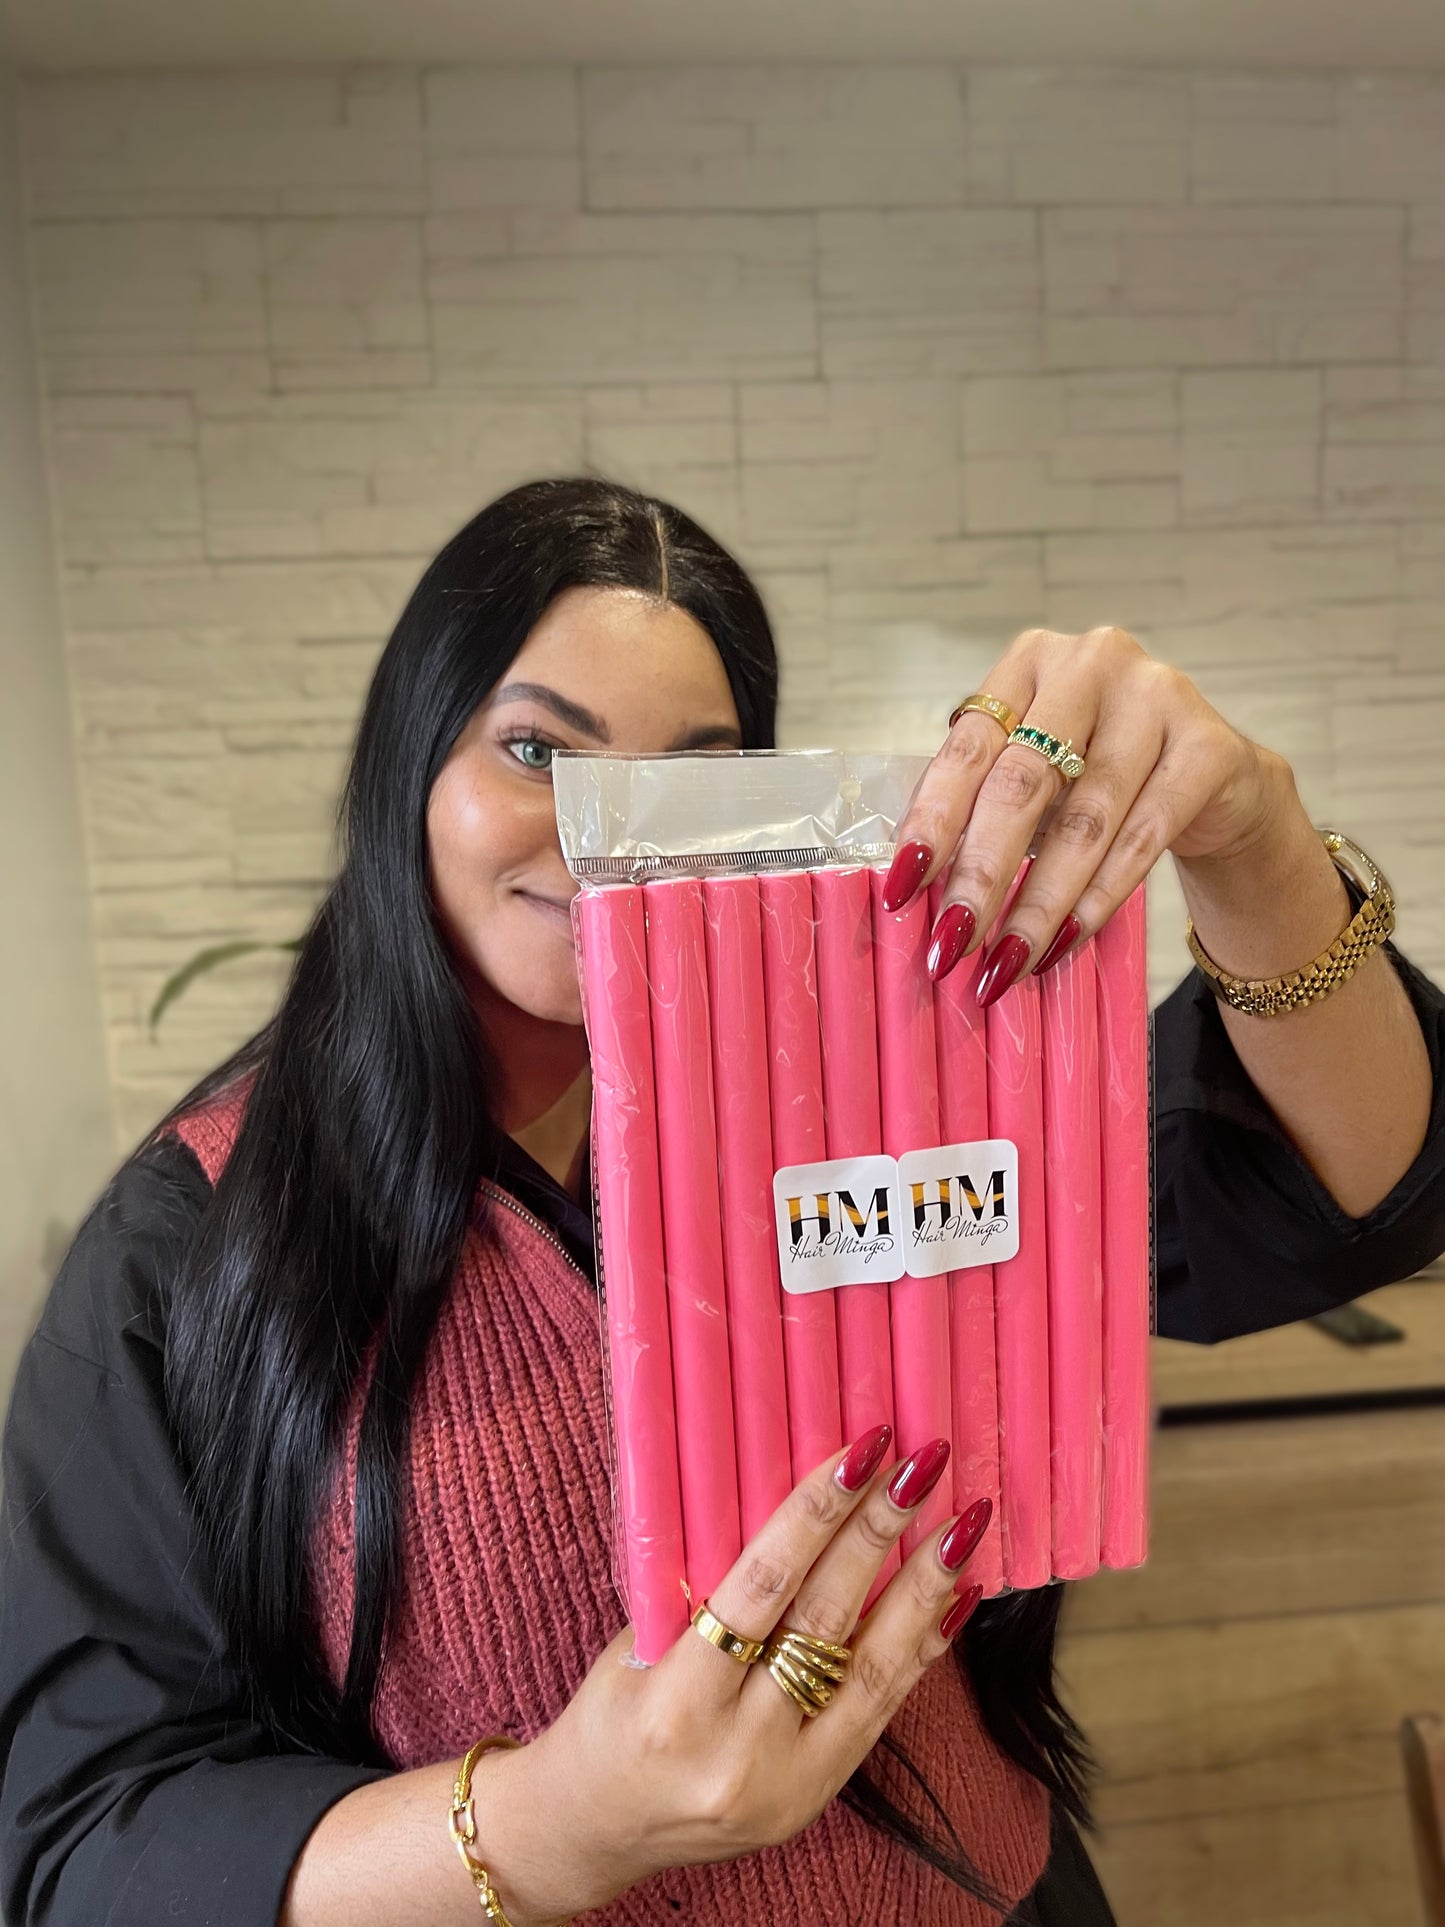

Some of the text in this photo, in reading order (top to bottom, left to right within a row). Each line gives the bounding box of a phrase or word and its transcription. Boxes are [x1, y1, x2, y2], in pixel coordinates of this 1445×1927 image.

[784, 1187, 893, 1246] HM
[908, 1170, 1008, 1231] HM
[789, 1231, 894, 1264] Hair Minga
[912, 1215, 1009, 1248] Hair Minga
